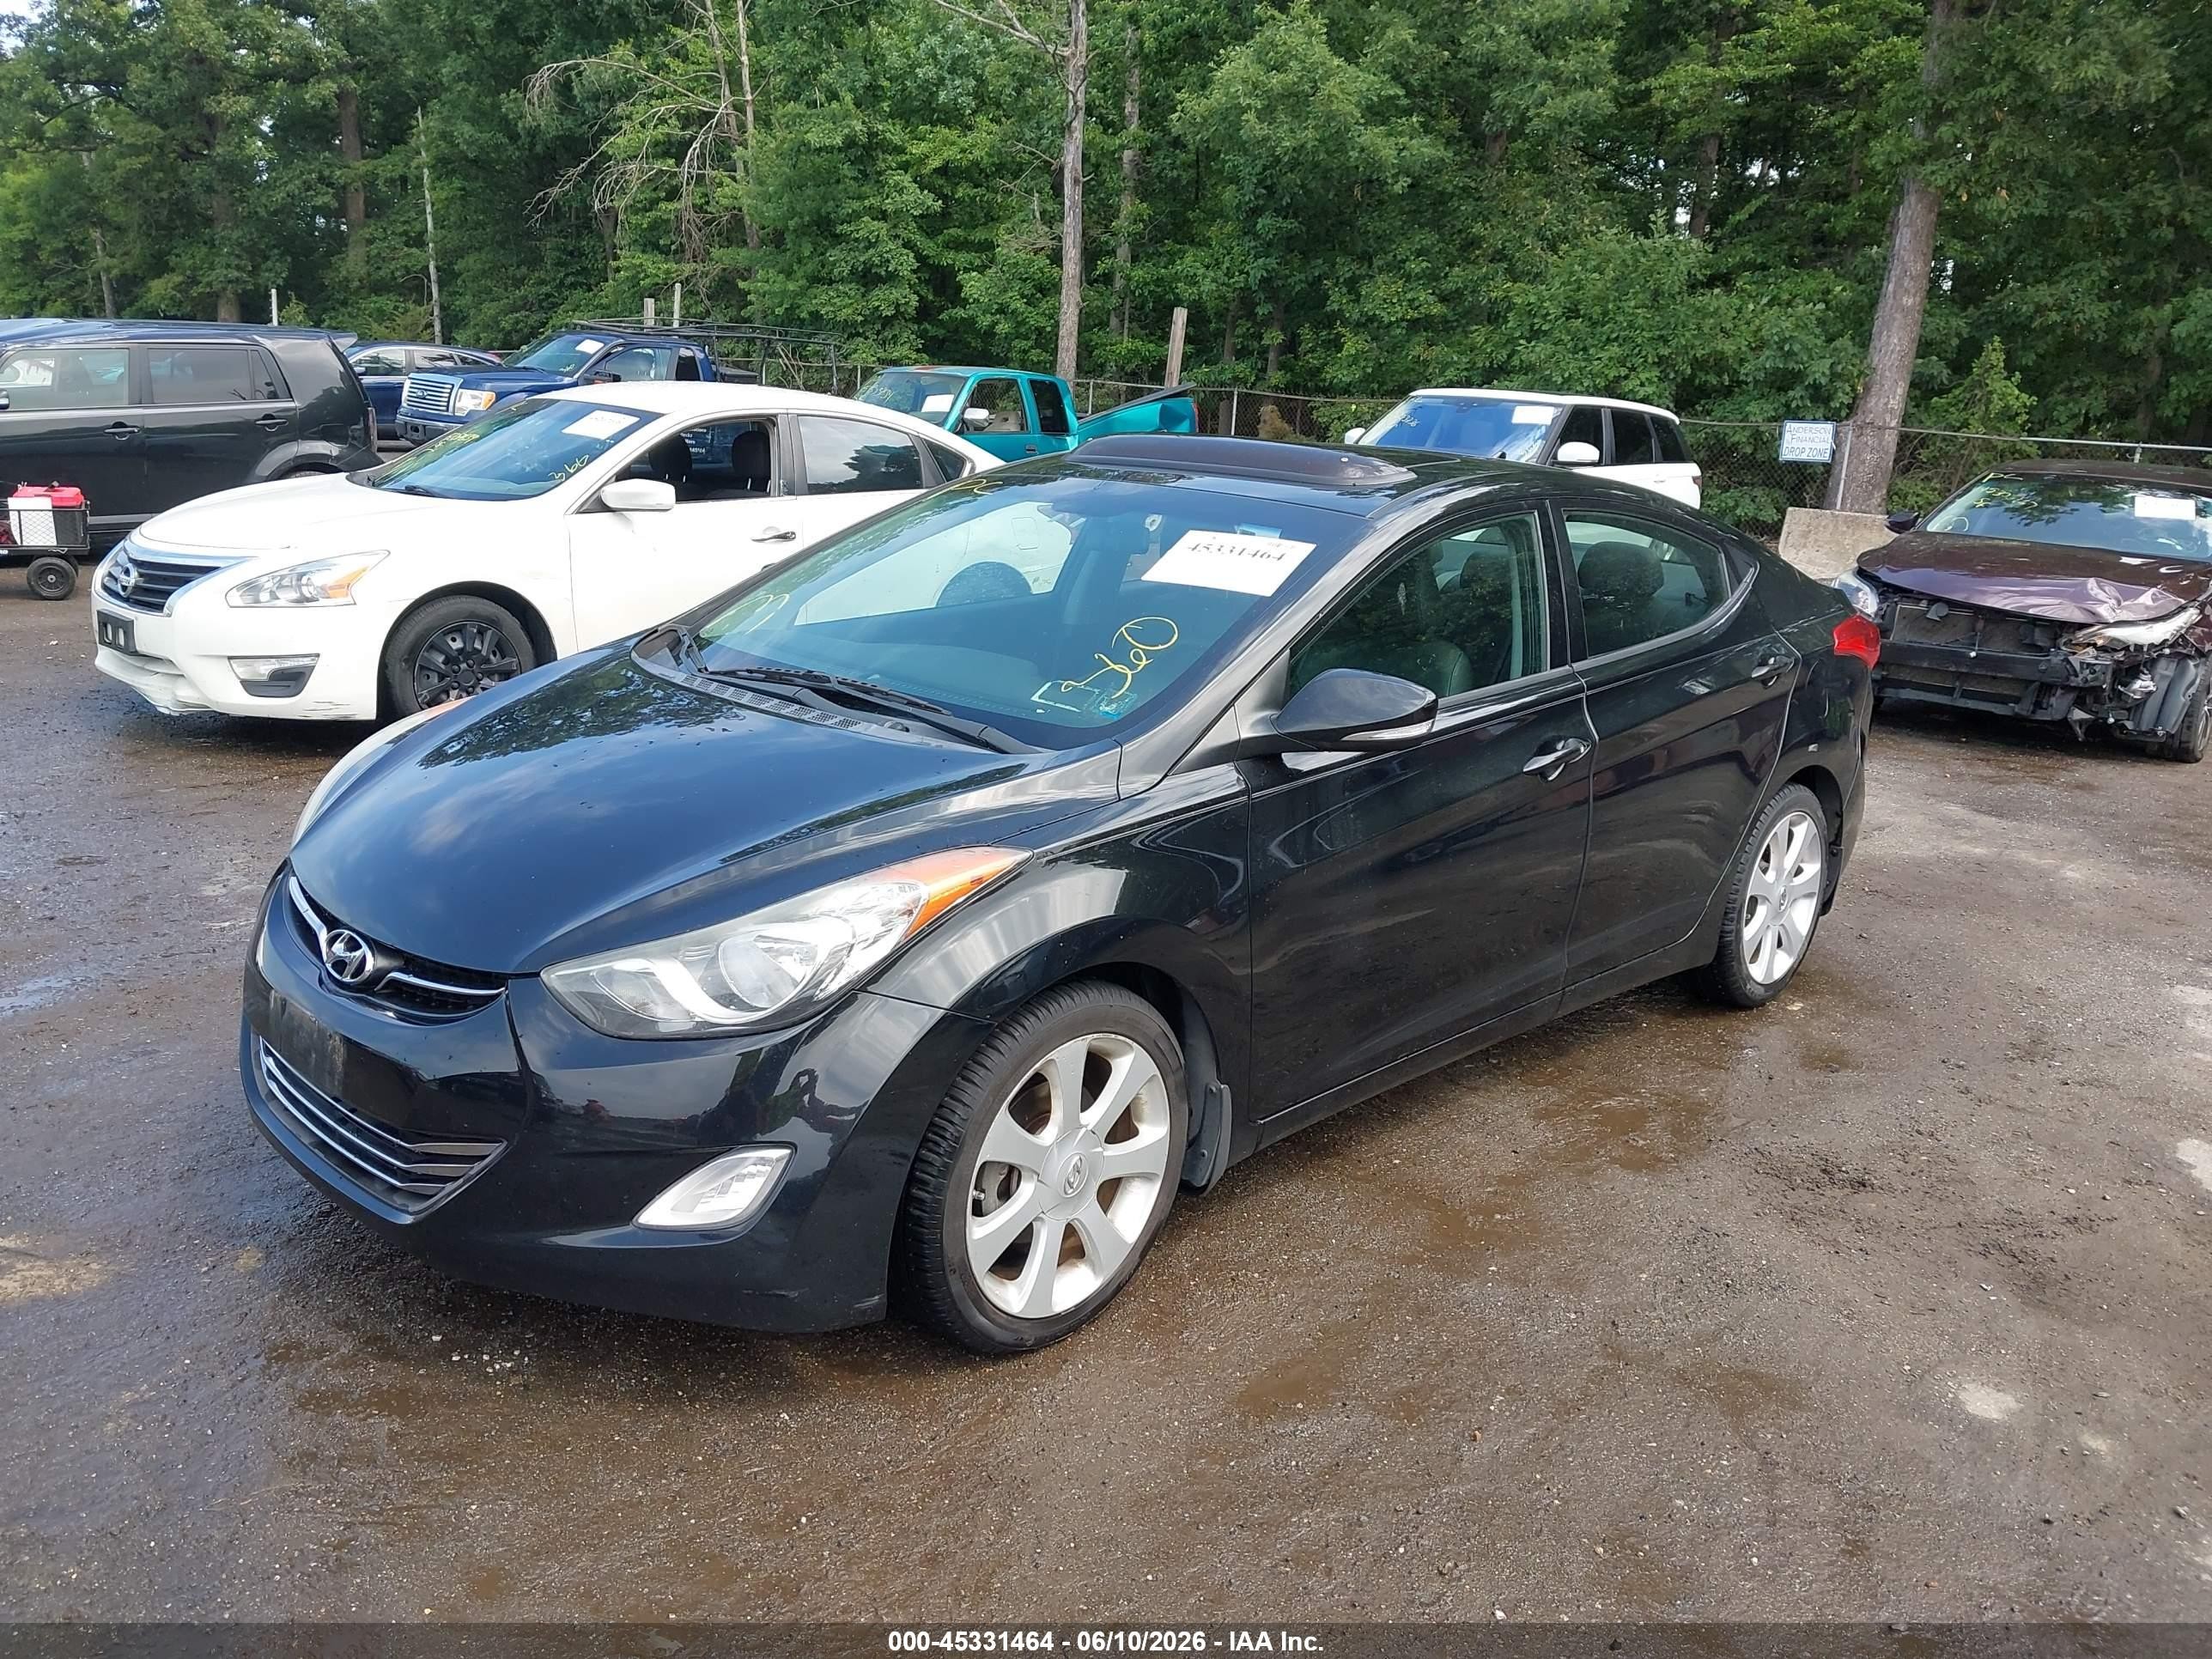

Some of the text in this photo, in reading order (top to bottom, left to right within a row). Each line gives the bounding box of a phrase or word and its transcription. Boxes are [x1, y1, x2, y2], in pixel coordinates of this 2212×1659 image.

[1786, 424, 1832, 434] ANDERSON
[1790, 434, 1830, 444] FINANCIAL
[1784, 447, 1829, 459] DROP ZONE
[1188, 543, 1286, 562] 45331464
